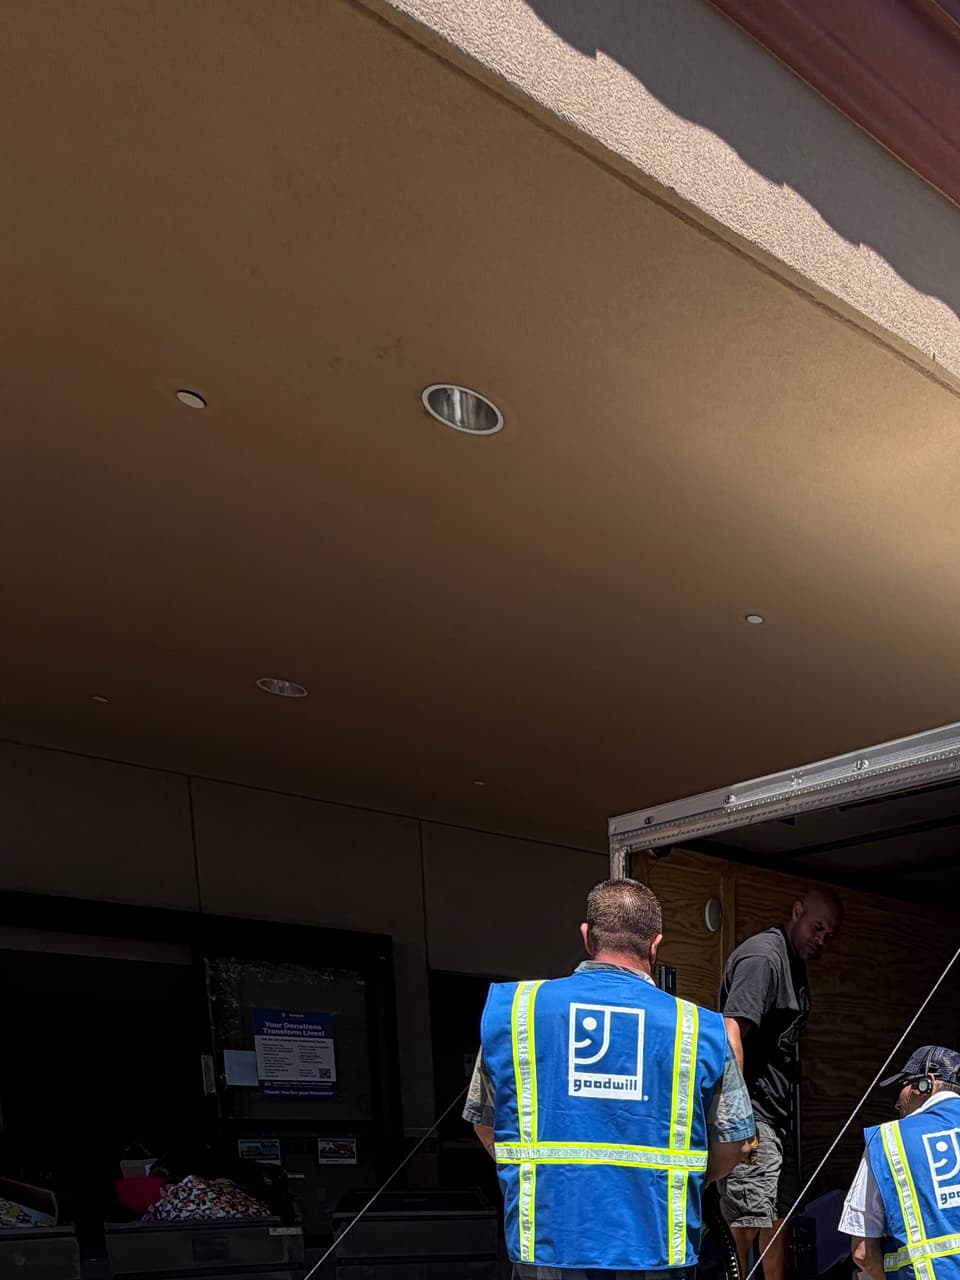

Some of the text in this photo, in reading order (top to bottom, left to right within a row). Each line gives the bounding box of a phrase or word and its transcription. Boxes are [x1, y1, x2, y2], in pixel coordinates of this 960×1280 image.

[284, 1022, 322, 1030] Donations
[263, 1027, 302, 1036] Transform
[573, 1077, 637, 1092] goodwill
